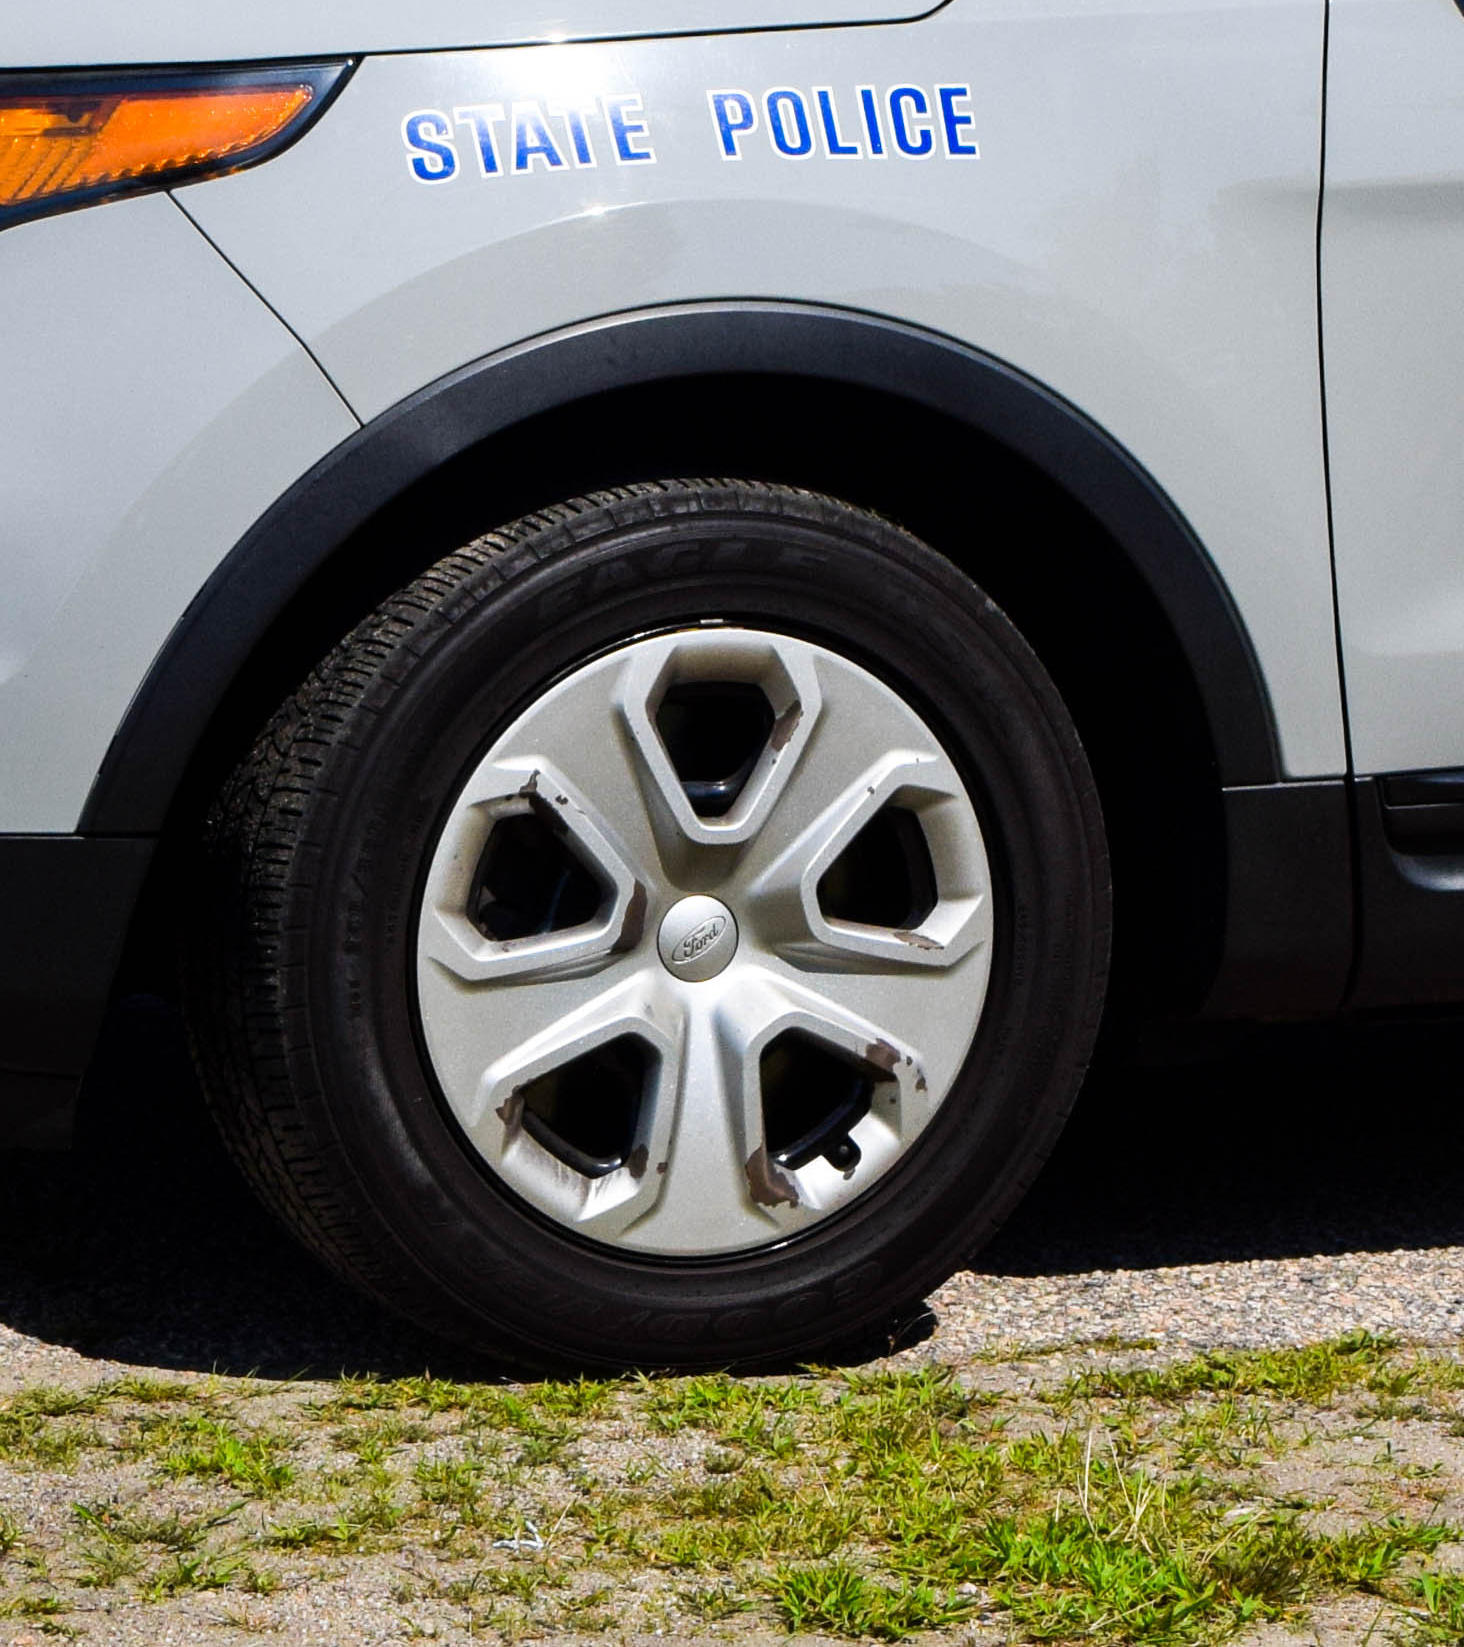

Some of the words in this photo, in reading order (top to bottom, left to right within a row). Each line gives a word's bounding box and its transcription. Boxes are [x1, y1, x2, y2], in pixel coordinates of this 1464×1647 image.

[400, 93, 657, 185] STATE
[710, 83, 981, 161] POLICE
[681, 922, 720, 958] Ford
